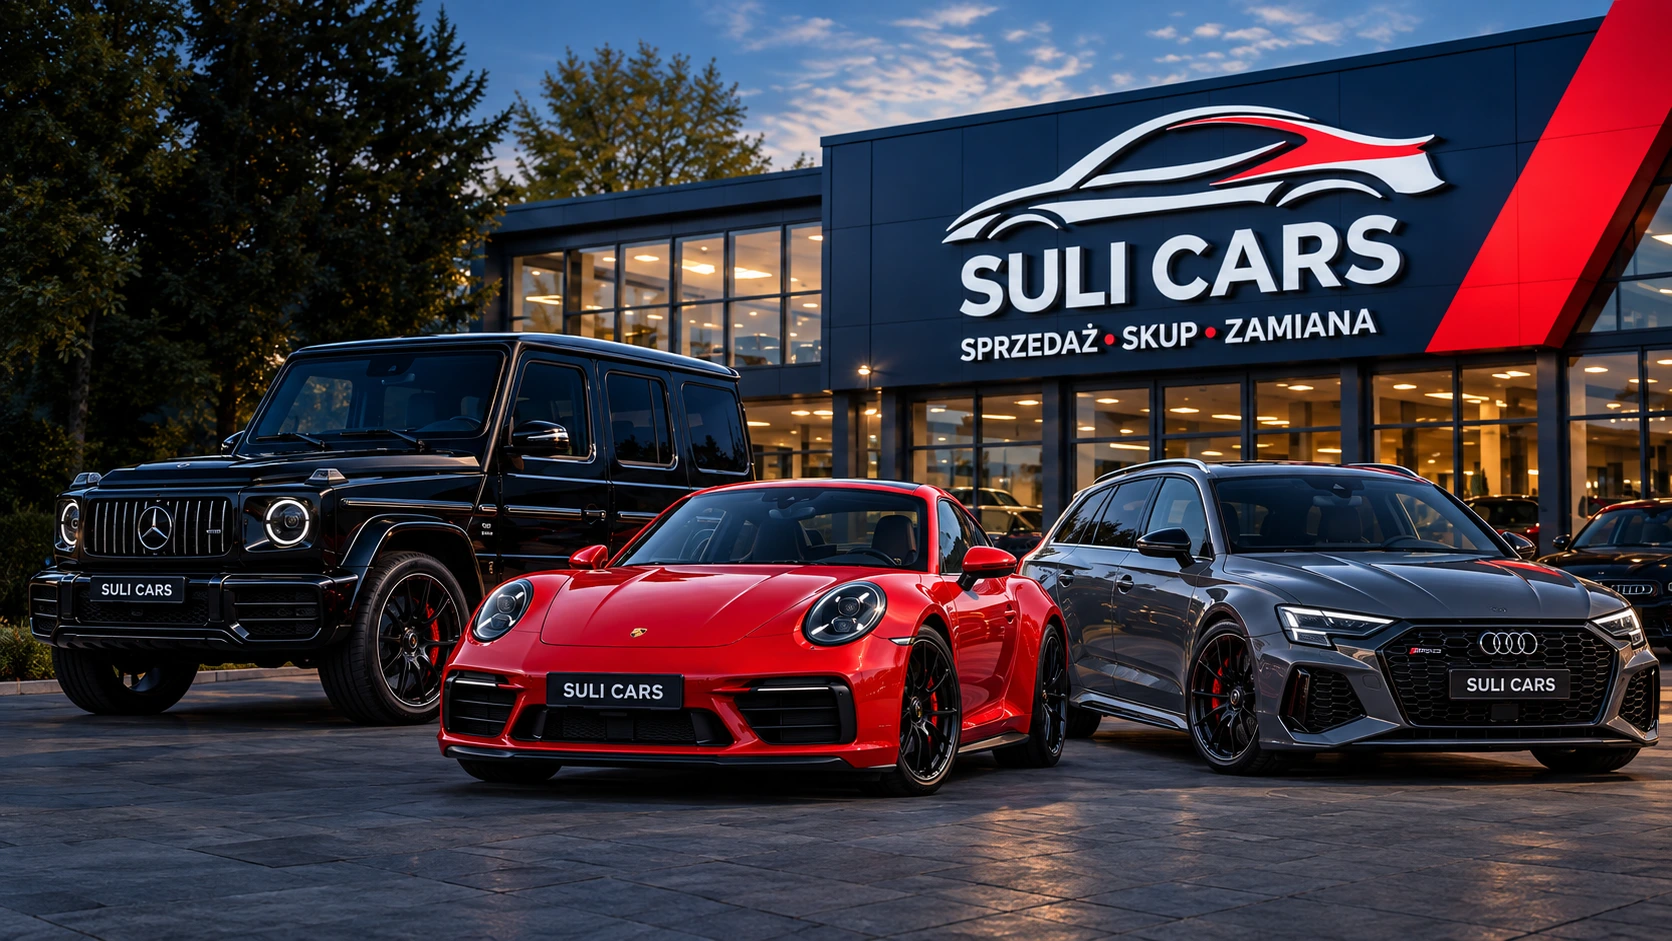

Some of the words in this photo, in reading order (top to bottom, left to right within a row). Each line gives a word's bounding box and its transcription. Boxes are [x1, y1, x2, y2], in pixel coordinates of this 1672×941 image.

[960, 241, 1126, 317] SULI
[1151, 214, 1402, 300] CARS
[960, 323, 1098, 362] SPRZEDAŻ
[1121, 321, 1198, 351] SKUP
[1224, 308, 1377, 344] ZAMIANA
[101, 583, 131, 596] SULI
[135, 583, 173, 596] CARS
[563, 682, 605, 699] SULI
[611, 683, 664, 700] CARS
[1466, 677, 1505, 692] SULI
[1510, 677, 1556, 692] CARS
